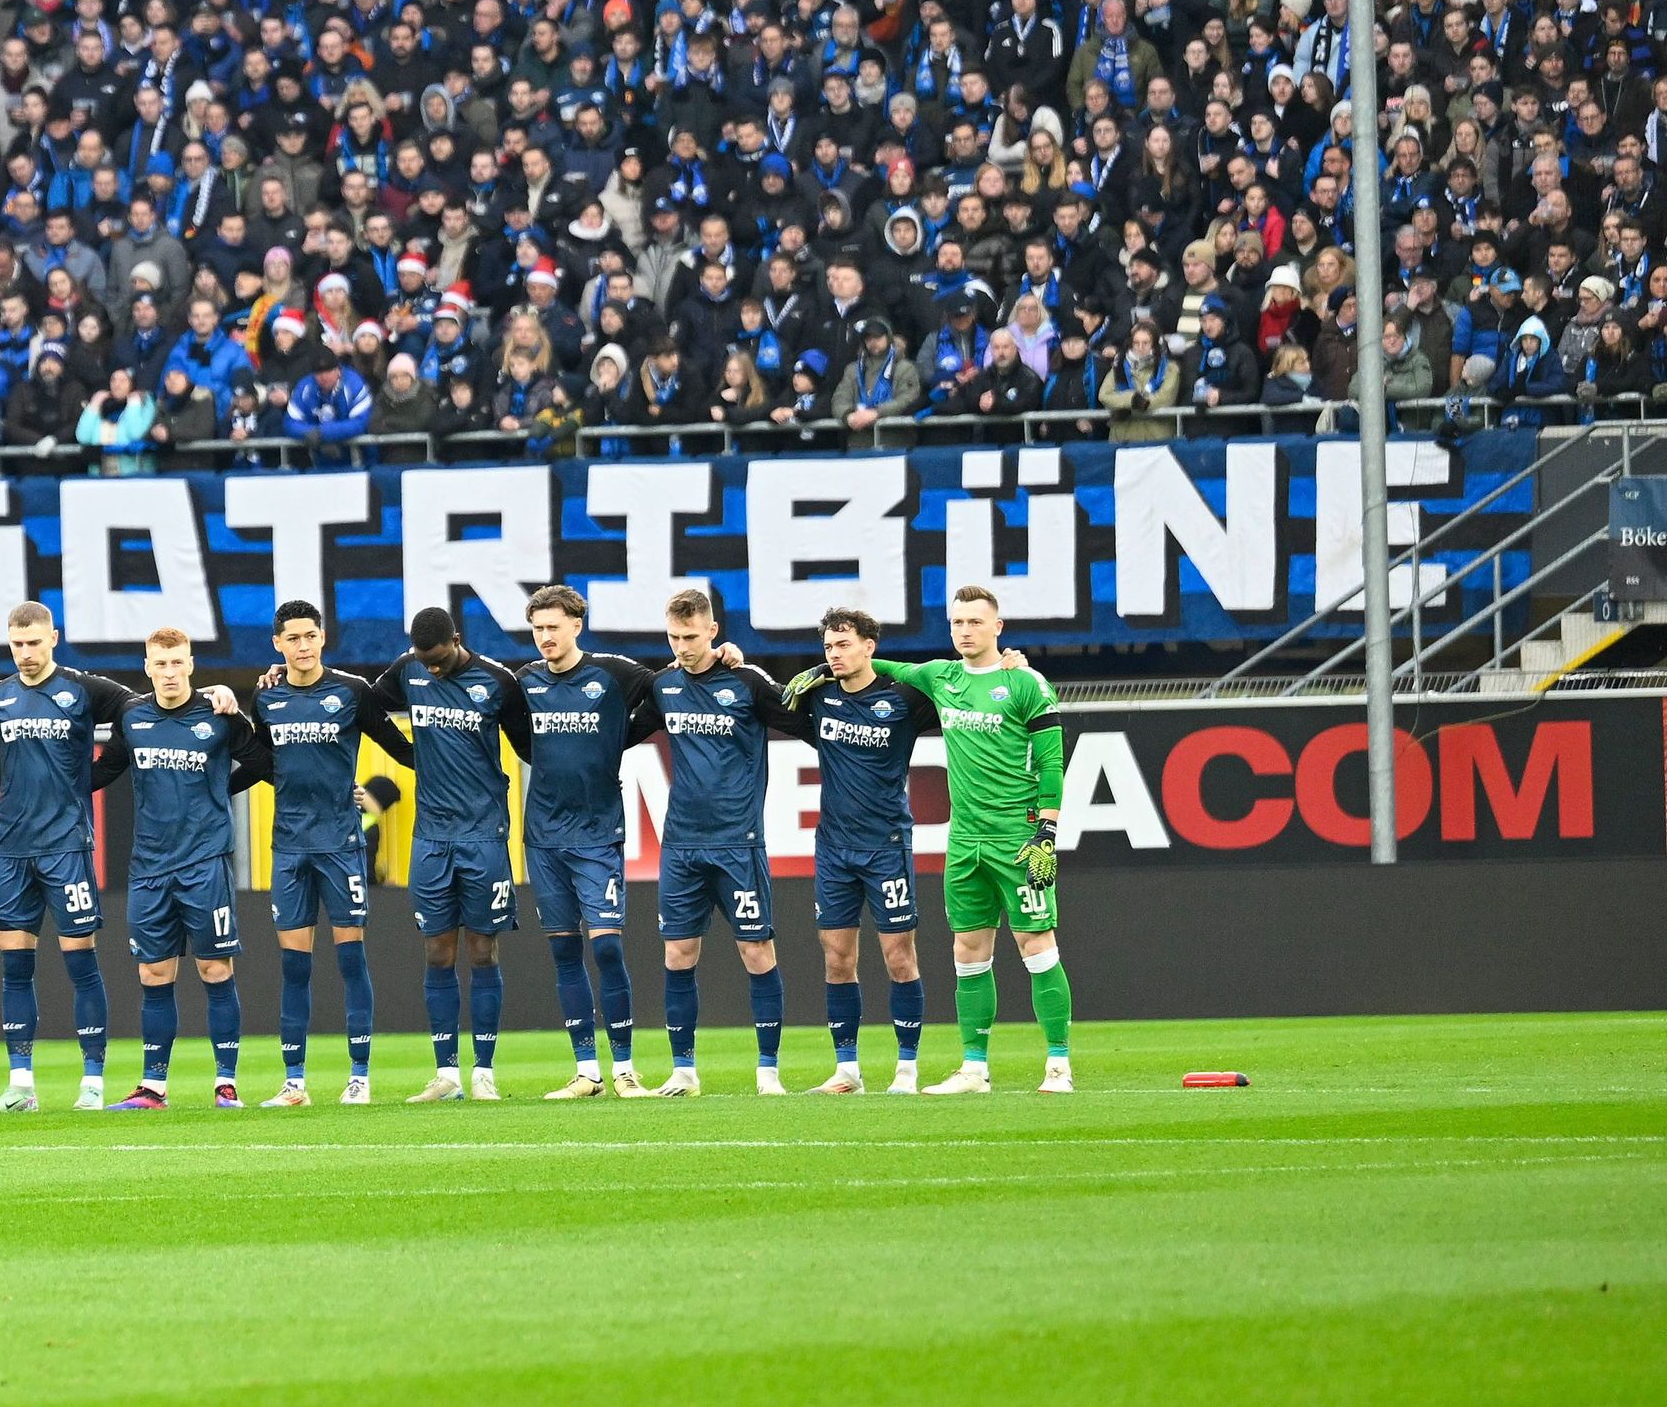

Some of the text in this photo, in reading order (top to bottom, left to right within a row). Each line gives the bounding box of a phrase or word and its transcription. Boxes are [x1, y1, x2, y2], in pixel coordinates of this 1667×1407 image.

[426, 716, 481, 732] PHARMA
[544, 722, 599, 733] PHARMA
[680, 723, 733, 736] PHARMA
[952, 720, 1002, 734] PHARMA
[15, 727, 69, 740] PHARMA
[282, 733, 338, 744] PHARMA
[836, 730, 889, 748] PHARMA
[151, 759, 205, 772] PHARMA
[64, 882, 92, 913] 36
[348, 875, 364, 904] 5
[491, 880, 510, 910] 29
[605, 878, 617, 906] 4
[882, 878, 909, 909] 32
[734, 890, 760, 919] 25
[213, 906, 230, 937] 17
